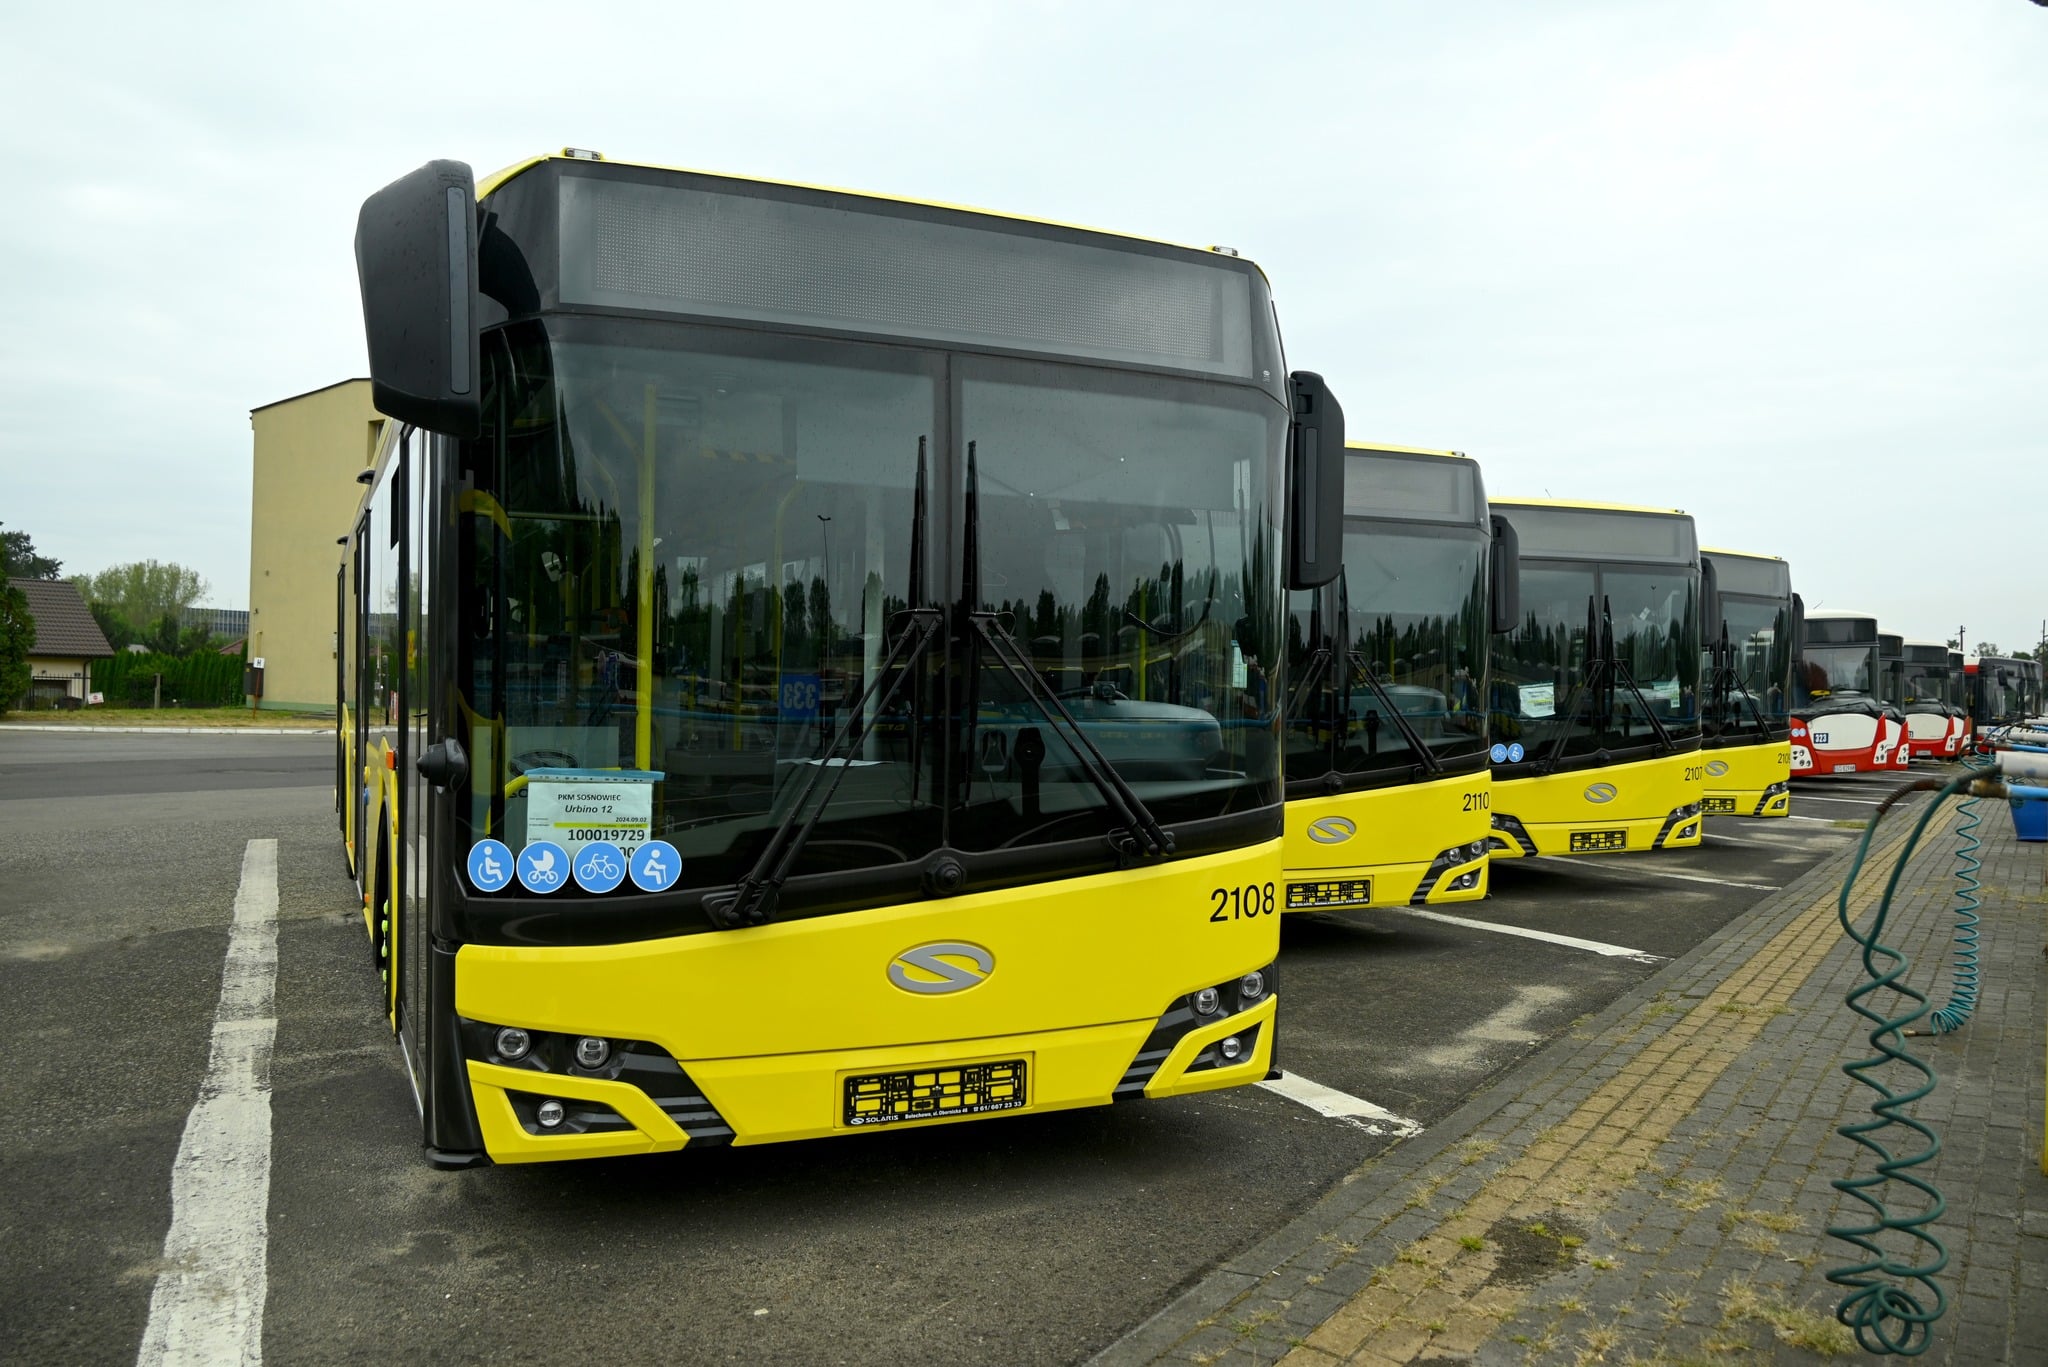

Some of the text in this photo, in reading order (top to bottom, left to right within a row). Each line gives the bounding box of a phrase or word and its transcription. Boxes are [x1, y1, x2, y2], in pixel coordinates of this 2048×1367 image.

[1684, 766, 1703, 781] 2107
[1462, 792, 1490, 811] 2110
[564, 805, 613, 814] Urbino 12
[567, 829, 645, 841] 100019729
[1209, 881, 1275, 923] 2108
[865, 1114, 899, 1123] SOLARIS
